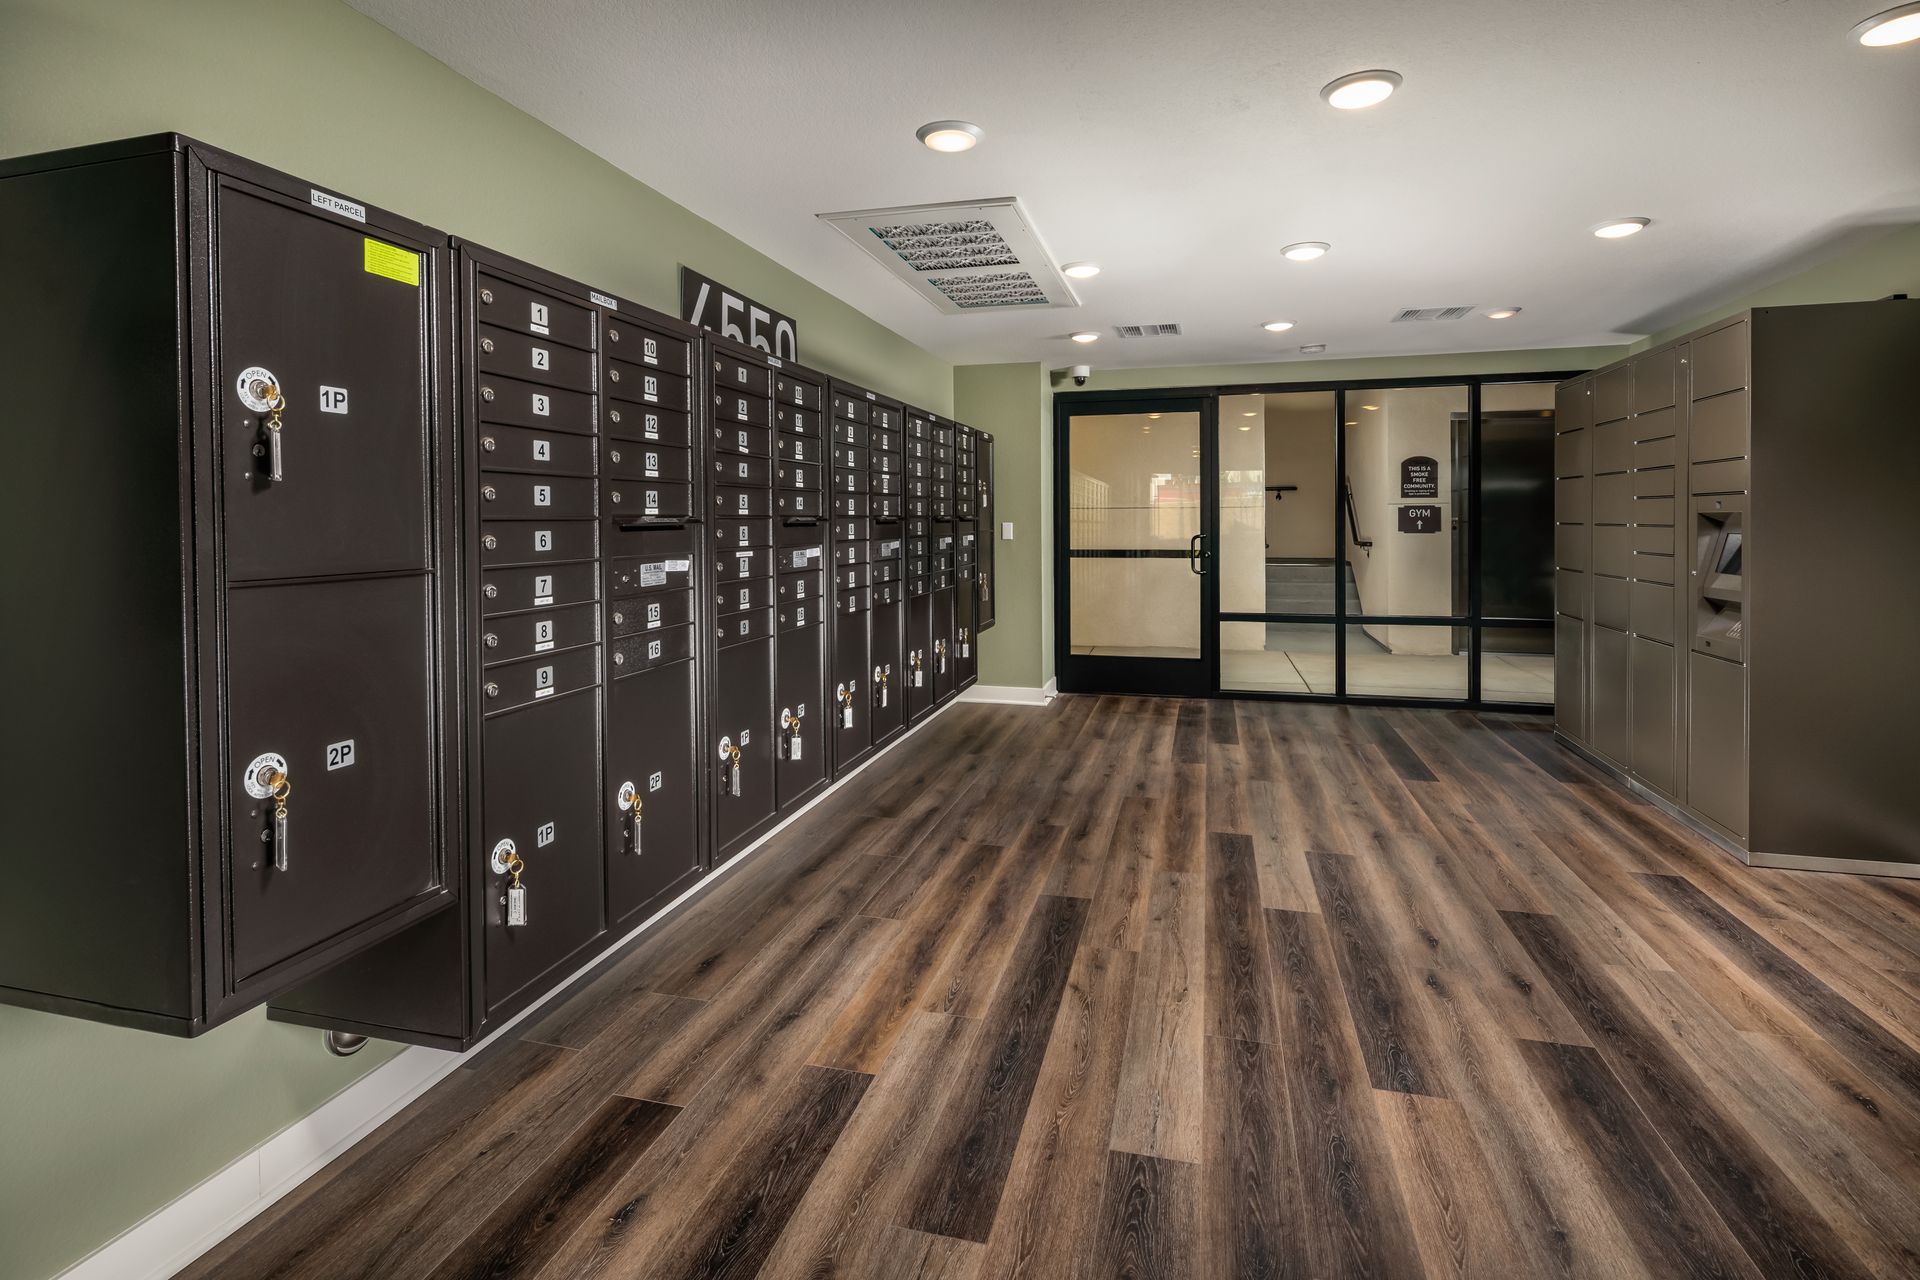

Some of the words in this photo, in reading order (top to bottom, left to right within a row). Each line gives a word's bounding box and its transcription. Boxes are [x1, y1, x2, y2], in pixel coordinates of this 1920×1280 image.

[312, 193, 332, 207] LEFT
[334, 200, 364, 219] PARCEL
[591, 293, 613, 305] MAILBOX
[537, 308, 543, 321] 1
[646, 341, 655, 355] 10
[537, 353, 544, 366] 2
[244, 370, 267, 379] OPEN
[646, 379, 656, 392] 11
[322, 390, 346, 408] 1P
[538, 398, 545, 411] 3
[741, 402, 745, 413] 2
[647, 417, 656, 430] 12
[741, 434, 745, 443] 3
[538, 444, 545, 457] 4
[647, 455, 657, 467] 13
[741, 465, 745, 477] 4
[539, 489, 546, 502] 5
[647, 493, 657, 505] 14
[741, 496, 746, 506] 5
[1409, 509, 1430, 517] GYM
[741, 528, 746, 538] 6
[540, 534, 547, 547] 6
[741, 560, 746, 569] 7
[540, 580, 547, 592] 7
[741, 591, 747, 602] 8
[649, 606, 659, 619] 15
[541, 625, 548, 638] 8
[742, 622, 747, 632] 9
[650, 643, 659, 656] 16
[542, 671, 548, 684] 9
[742, 732, 749, 744] 1P
[254, 756, 275, 768] OPEN
[329, 744, 352, 767] 2P
[650, 776, 661, 789] 2P
[538, 826, 553, 843] 1P
